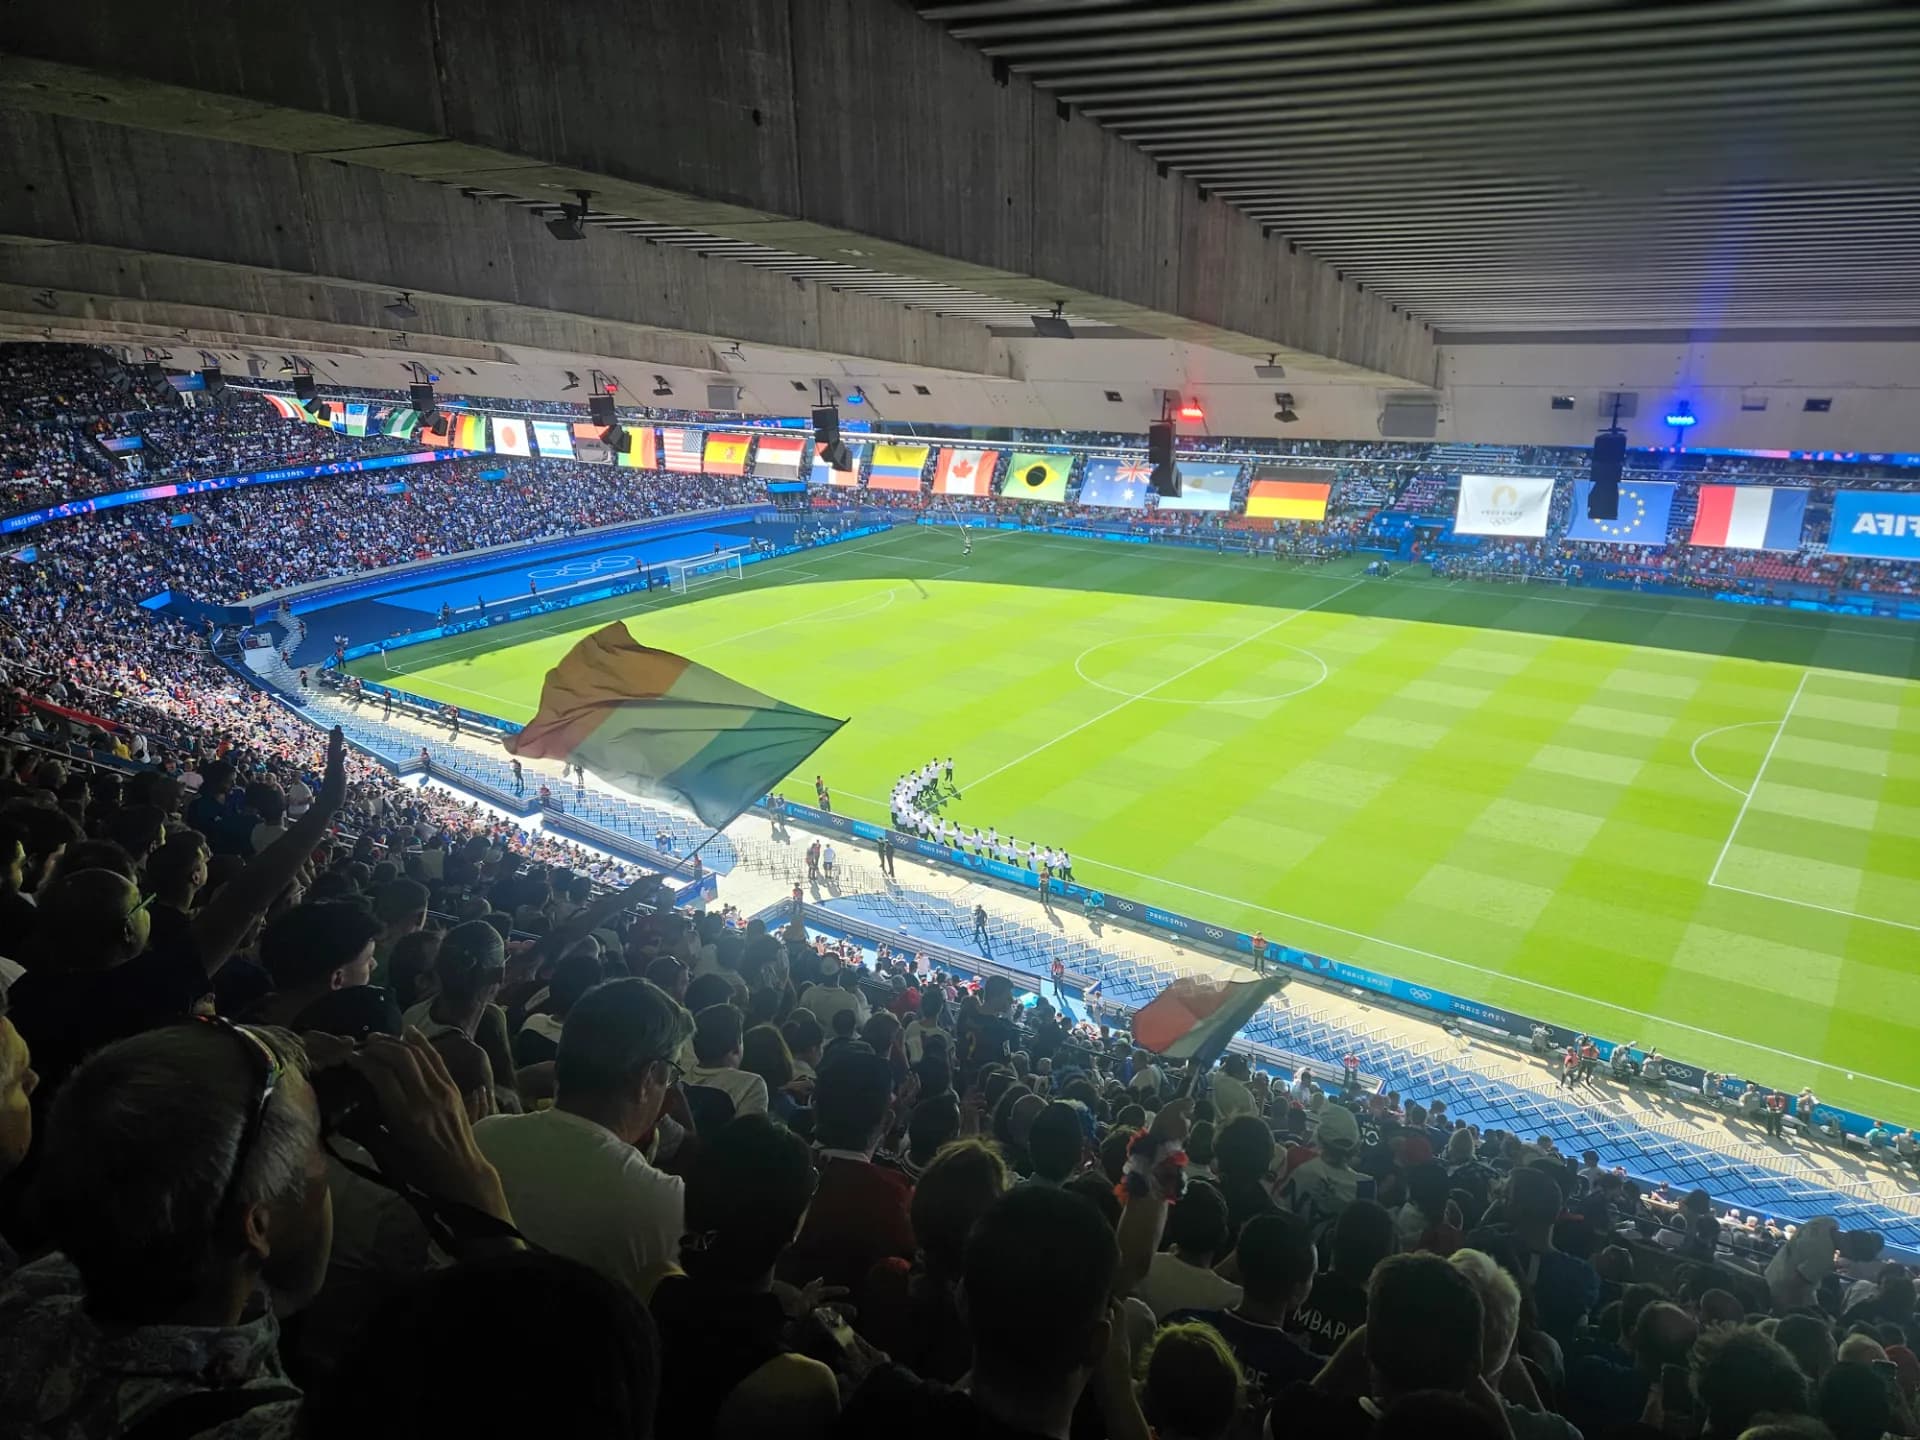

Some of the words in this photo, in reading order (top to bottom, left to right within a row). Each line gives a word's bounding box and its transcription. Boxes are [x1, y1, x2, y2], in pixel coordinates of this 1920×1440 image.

[1149, 911, 1169, 922] PARIS
[1170, 918, 1188, 928] 2024
[1453, 1001, 1480, 1015] PARIS
[1481, 1010, 1507, 1023] 2024
